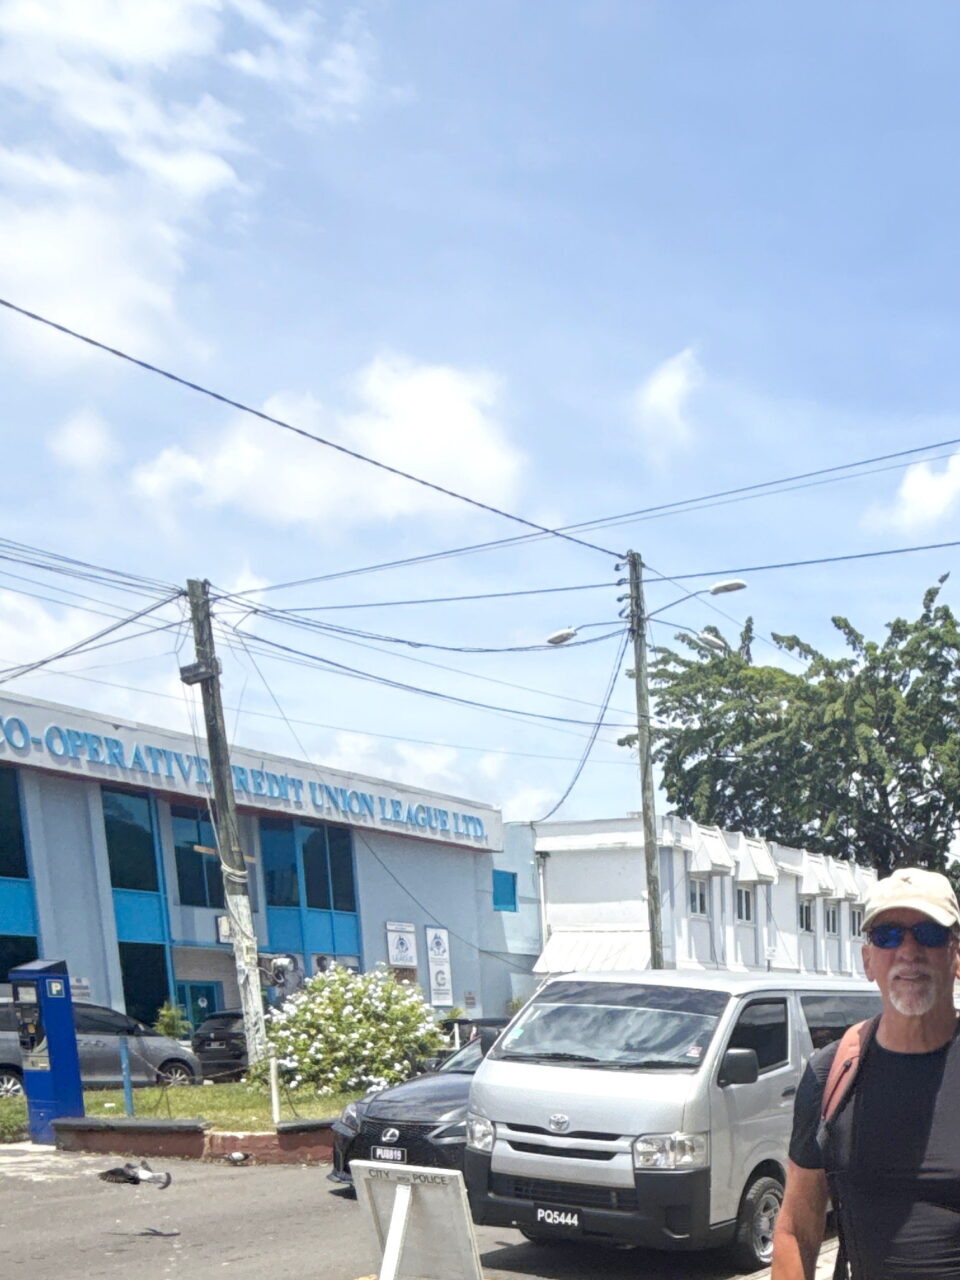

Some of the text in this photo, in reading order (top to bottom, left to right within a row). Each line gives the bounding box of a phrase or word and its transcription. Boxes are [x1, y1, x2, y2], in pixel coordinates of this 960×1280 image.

[0, 714, 488, 844] O-OPERATIVE REDIT UNION LEAGUE LTD.
[51, 981, 62, 995] P
[369, 1168, 390, 1179] CITY
[412, 1173, 448, 1185] POLICE
[537, 1208, 579, 1226] PQ5444
